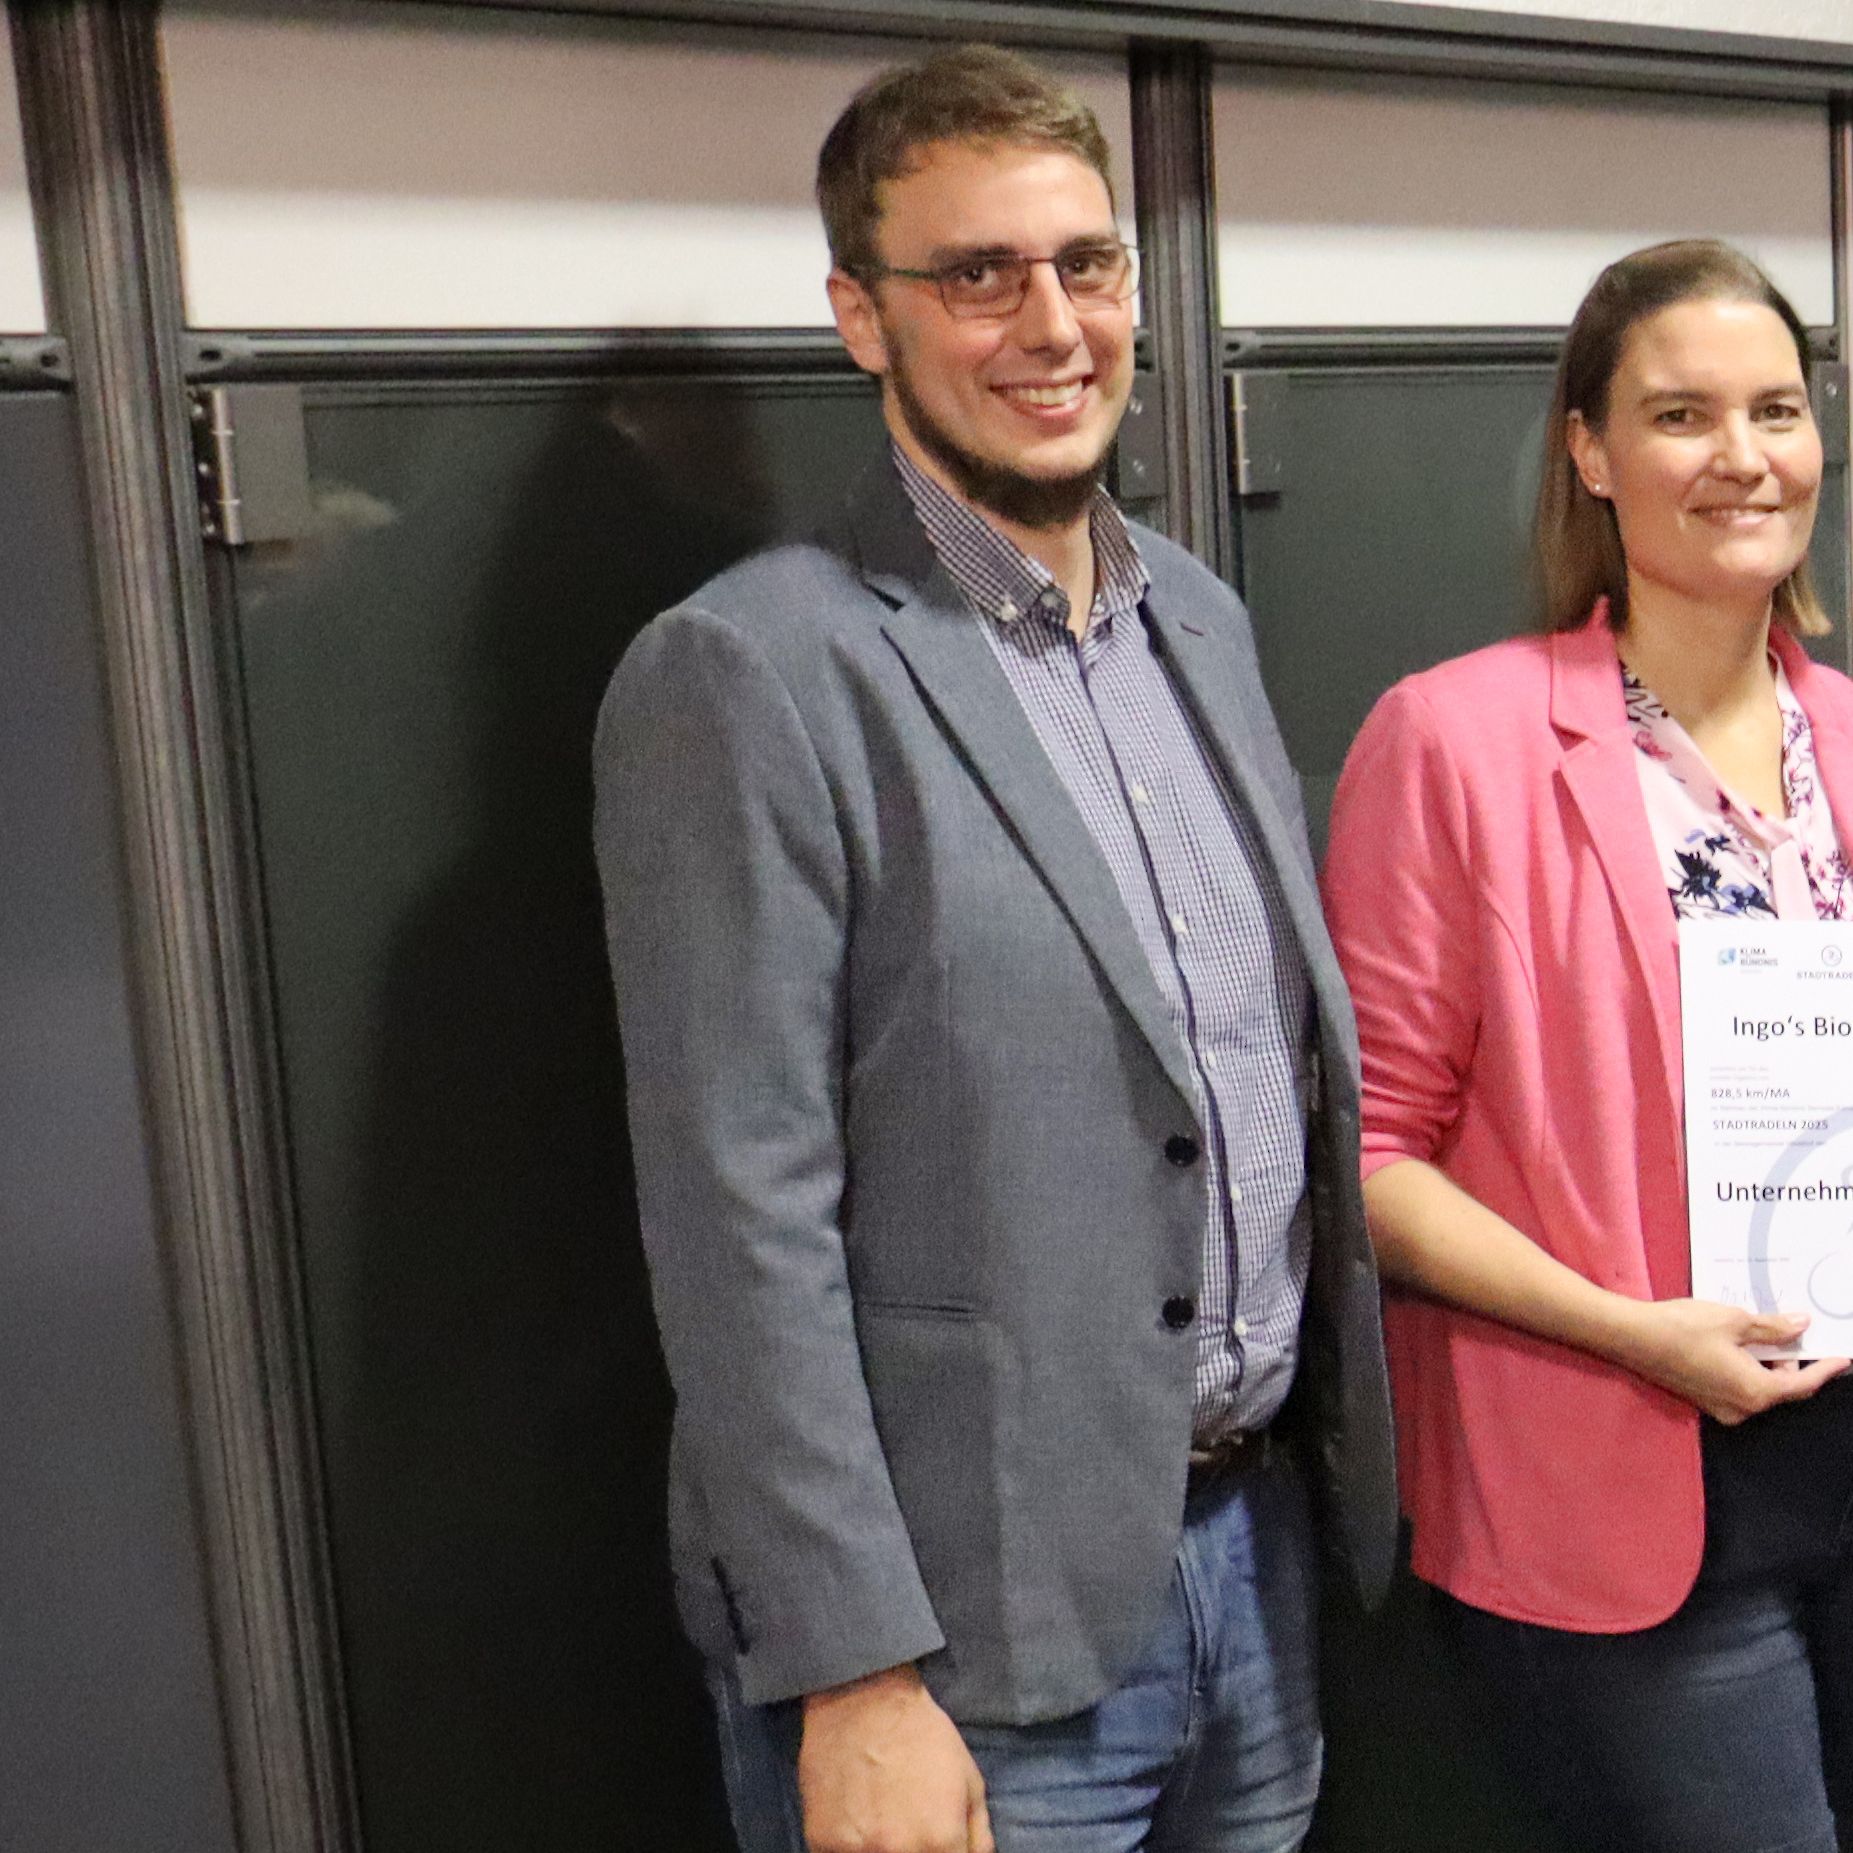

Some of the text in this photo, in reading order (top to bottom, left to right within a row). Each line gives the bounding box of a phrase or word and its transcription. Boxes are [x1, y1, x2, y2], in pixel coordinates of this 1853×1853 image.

[1746, 1087, 1790, 1100] km/MA
[1712, 1119, 1829, 1130] STADTRADELN 2025
